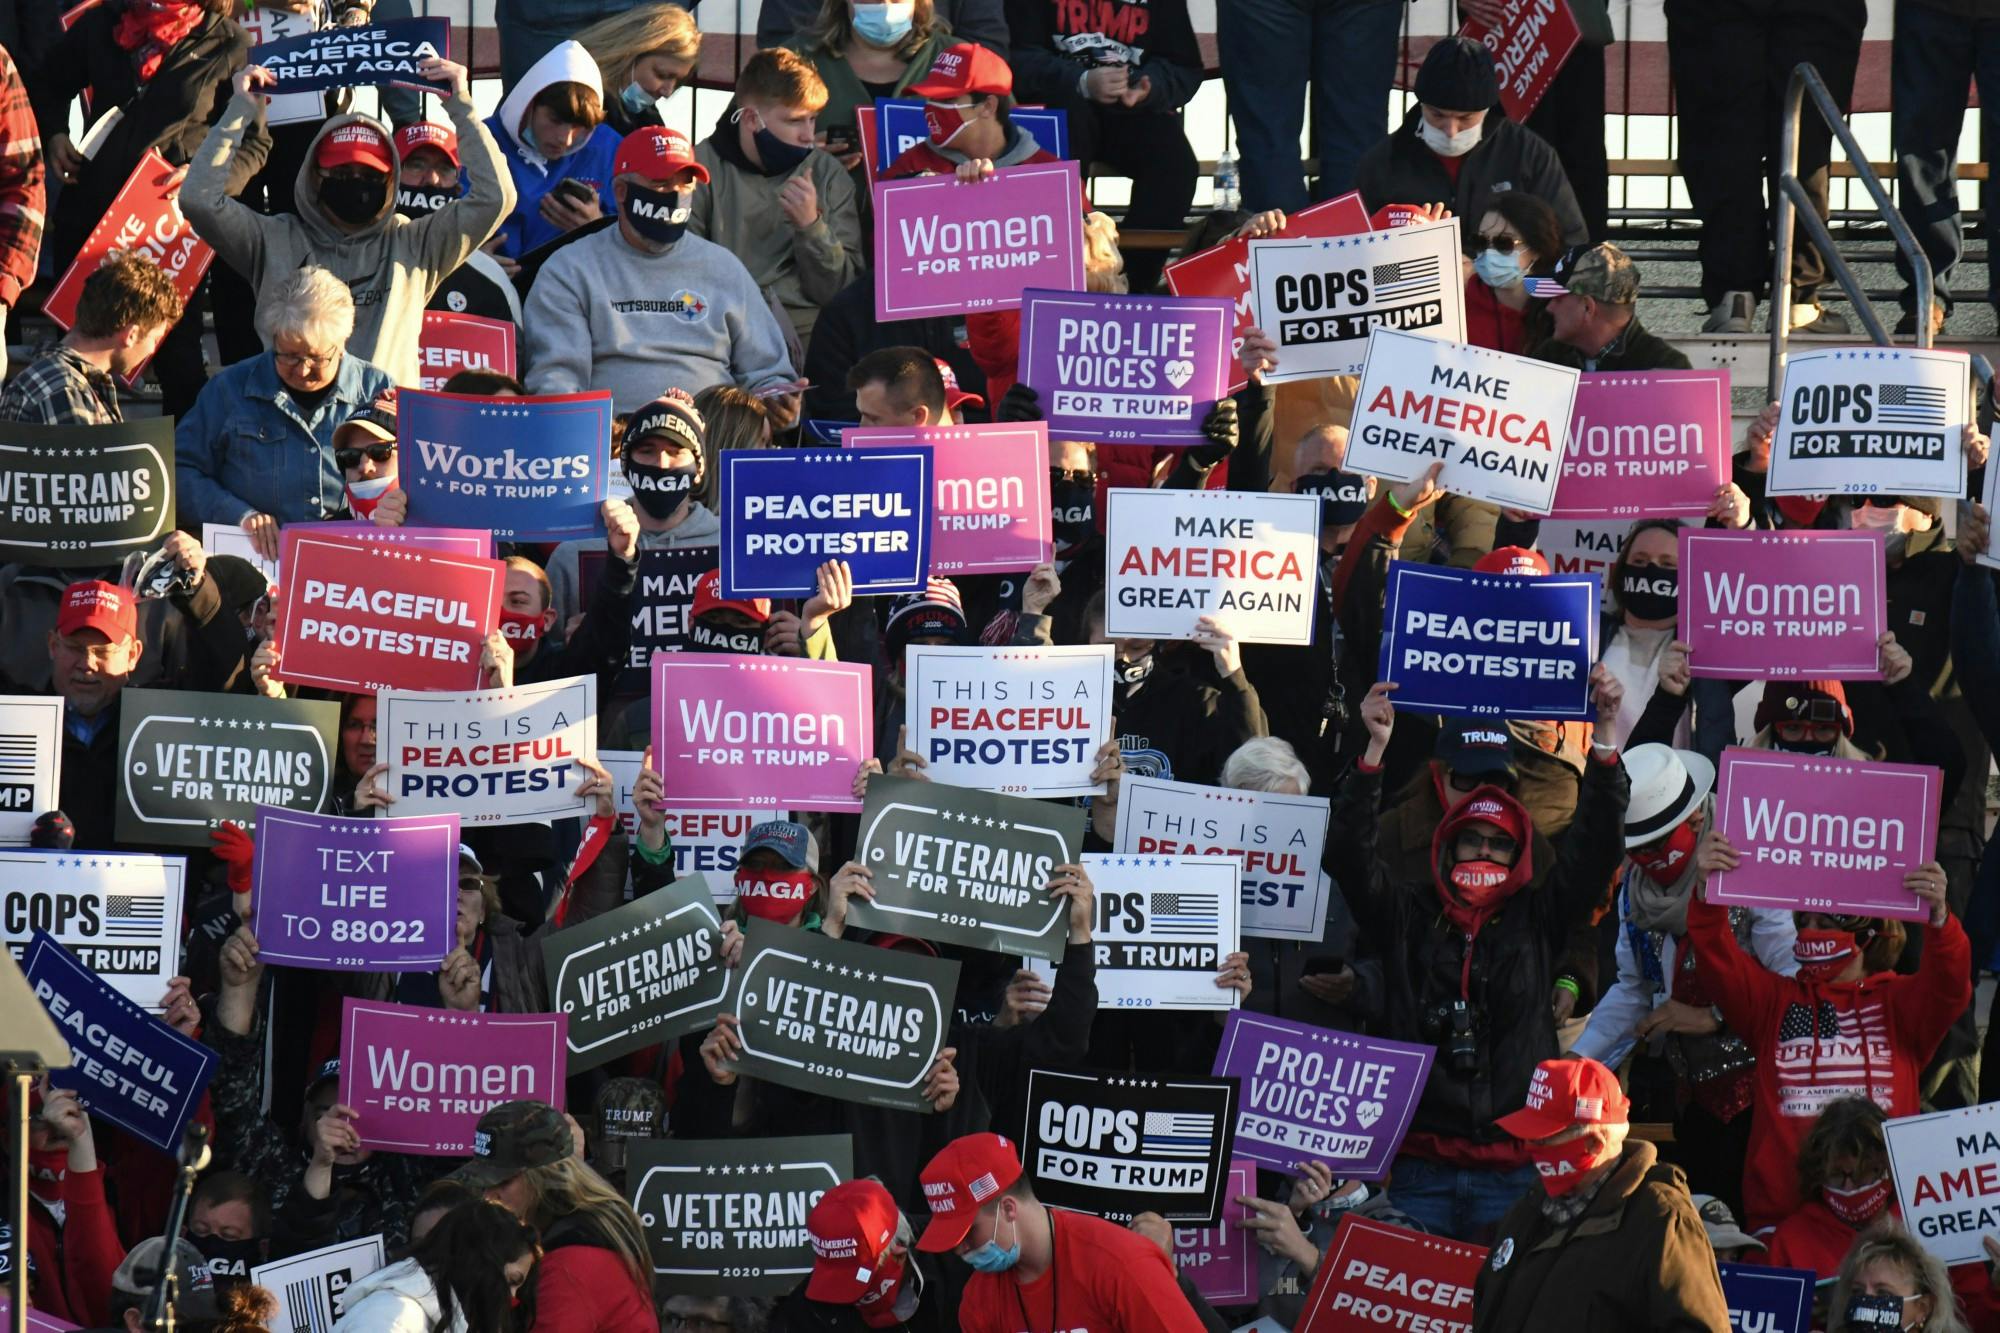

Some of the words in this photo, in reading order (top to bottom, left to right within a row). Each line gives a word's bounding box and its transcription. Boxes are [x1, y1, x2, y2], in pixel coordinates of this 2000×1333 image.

[310, 30, 387, 46] MAKE
[261, 41, 440, 66] AMERICA
[356, 60, 425, 74] AGAI
[1513, 42, 1550, 99] MAKE
[900, 214, 1054, 258] Women
[918, 258, 960, 275] FOR
[967, 251, 1041, 271] TRUMP
[967, 298, 993, 308] 2020
[1275, 268, 1369, 314] COPS
[1284, 320, 1340, 342] FOR
[1350, 304, 1440, 335] TRUMP
[1058, 318, 1196, 357] PRO-LIFE
[1057, 354, 1156, 389] VOICES
[1431, 365, 1510, 400] MAKE
[1057, 396, 1102, 413] FOR
[1112, 398, 1189, 415] TRUMP
[1792, 383, 1873, 425] COPS
[1368, 385, 1552, 452] AMERICA
[1108, 430, 1136, 439] 2020
[1793, 435, 1841, 455] FOR
[1851, 434, 1942, 456] TRUMP
[415, 439, 591, 481] Workers
[1362, 424, 1455, 459] GREAT
[1460, 446, 1549, 482] AGAIN
[628, 468, 691, 493] MAGA
[1563, 462, 1607, 477] FOR
[1615, 460, 1690, 476] TRUMP
[449, 481, 487, 497] FOR
[494, 484, 558, 499] TRUMP
[938, 476, 1024, 511] men
[1844, 483, 1878, 492] 2020
[11, 506, 52, 524] FOR
[59, 504, 136, 525] TRUMP
[744, 493, 911, 520] PEACEFUL
[1613, 506, 1640, 514] 2020
[939, 515, 1010, 531] TRUMP
[1175, 516, 1254, 539] MAKE
[51, 540, 87, 549] 2020
[746, 531, 909, 555] PROTESTER
[1575, 529, 1627, 552] MAK
[1118, 545, 1303, 582] AMERICA
[303, 579, 477, 629] PEACEFUL
[1118, 587, 1210, 609] GREAT
[1219, 590, 1302, 613] AGAIN
[1704, 571, 1861, 617] Women
[694, 626, 760, 653] MAGA
[1406, 610, 1580, 646] PEACEFUL
[1720, 619, 1766, 636] FOR
[1773, 620, 1847, 636] TRUMP
[300, 619, 471, 664] PROTESTER
[1404, 648, 1577, 681] PROTESTER
[1769, 667, 1797, 675] 2020
[364, 681, 392, 690] 2020
[932, 680, 1009, 701] THIS
[1029, 680, 1055, 700] IS
[1073, 679, 1089, 699] A
[931, 707, 1091, 731] PEACEFUL
[1472, 705, 1500, 714] 2020
[404, 720, 482, 741] THIS
[504, 716, 531, 737] IS
[552, 711, 570, 731] A
[679, 699, 844, 747] Women
[1462, 731, 1508, 745] TRUMP
[402, 736, 572, 768] PEACEFUL
[698, 748, 744, 765] FOR
[752, 750, 830, 766] TRUMP
[930, 738, 1090, 765] PROTEST
[155, 742, 312, 787] VETERANS
[171, 781, 213, 800] FOR
[222, 784, 294, 806] TRUMP
[401, 764, 573, 799] PROTEST
[1001, 785, 1028, 793] 2020
[748, 796, 777, 805] 2020
[474, 813, 501, 822] 2020
[1143, 810, 1218, 839] THIS
[1240, 823, 1268, 844] IS
[1289, 829, 1307, 847] A
[1743, 797, 1904, 852] Women
[317, 848, 395, 873] TEXT
[895, 831, 1053, 891] VETERANS
[1757, 847, 1802, 865] FOR
[1811, 851, 1888, 871] TRUMP
[738, 881, 805, 900] MAGA
[906, 871, 948, 894] FOR
[957, 880, 1030, 907] TRUMP
[1455, 871, 1507, 887] TRUMP
[321, 884, 387, 908] LIFE
[1804, 898, 1832, 907] 2020
[4, 892, 100, 936] COPS
[941, 913, 977, 927] 2020
[282, 914, 320, 940] TO
[331, 920, 425, 943] 88022
[77, 948, 159, 972] TRUMP
[336, 957, 364, 966] 2020
[578, 926, 713, 1007] VETERANS
[1122, 946, 1216, 969] TRUMP
[595, 997, 631, 1023] FOR
[636, 967, 700, 1005] TRUMP
[1117, 998, 1152, 1007] 2020
[766, 976, 924, 1044] VETERANS
[35, 978, 178, 1095] PEACEFUL
[631, 1014, 662, 1034] 2020
[775, 1018, 817, 1045] FOR
[824, 1029, 901, 1062] TRUMP
[367, 1045, 535, 1094] Women
[807, 1061, 844, 1079] 2020
[1255, 1042, 1396, 1099] PRO-LIFE
[71, 1047, 170, 1118] TESTER
[384, 1095, 430, 1113] FOR
[1250, 1077, 1350, 1127] VOICES
[605, 1108, 653, 1122] TRUMP
[1039, 1101, 1138, 1154] COPS
[435, 1142, 464, 1151] 2020
[1240, 1117, 1288, 1142] FOR
[1298, 1131, 1369, 1156] TRUMP
[1042, 1155, 1098, 1180] FOR
[1110, 1164, 1205, 1188] TRUMP
[1104, 1211, 1133, 1222] 2020
[681, 1231, 724, 1249] FOR
[733, 1228, 810, 1248] TRUMP
[821, 1238, 858, 1250] AMERICA
[829, 1248, 857, 1259] AGAIN
[722, 1267, 760, 1277] 2020
[1344, 1259, 1475, 1309] PEACEF
[1879, 1310, 1900, 1326] 2020
